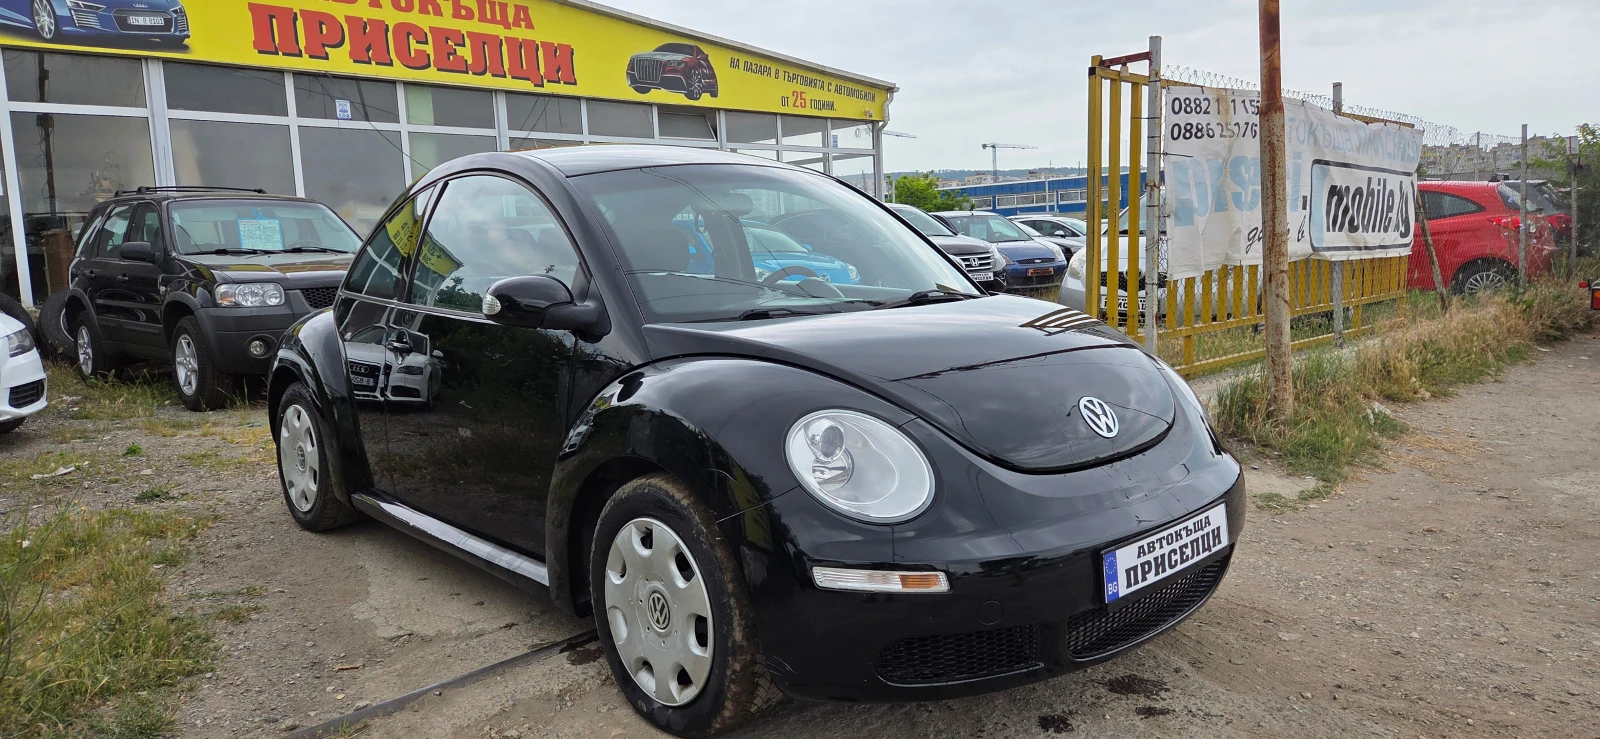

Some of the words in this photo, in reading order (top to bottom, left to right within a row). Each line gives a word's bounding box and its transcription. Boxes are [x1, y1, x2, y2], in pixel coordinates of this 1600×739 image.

[248, 2, 577, 87] ПРИСЕЛЦИ
[730, 56, 740, 70] НА
[743, 60, 772, 77] ПАЗАРА
[774, 68, 780, 80] В
[782, 70, 825, 91] ТЪРГОВИЯТА
[827, 82, 832, 92] С
[834, 83, 876, 103] АВТОМОБИЛИ
[781, 95, 790, 107] ОТ
[791, 90, 807, 109] 25
[810, 98, 837, 112] ГОДИНИ.
[1124, 525, 1222, 590] ПРИСЕЛЦИ
[1136, 514, 1212, 560] АВТОКЪЩА
[1107, 581, 1118, 595] BG
